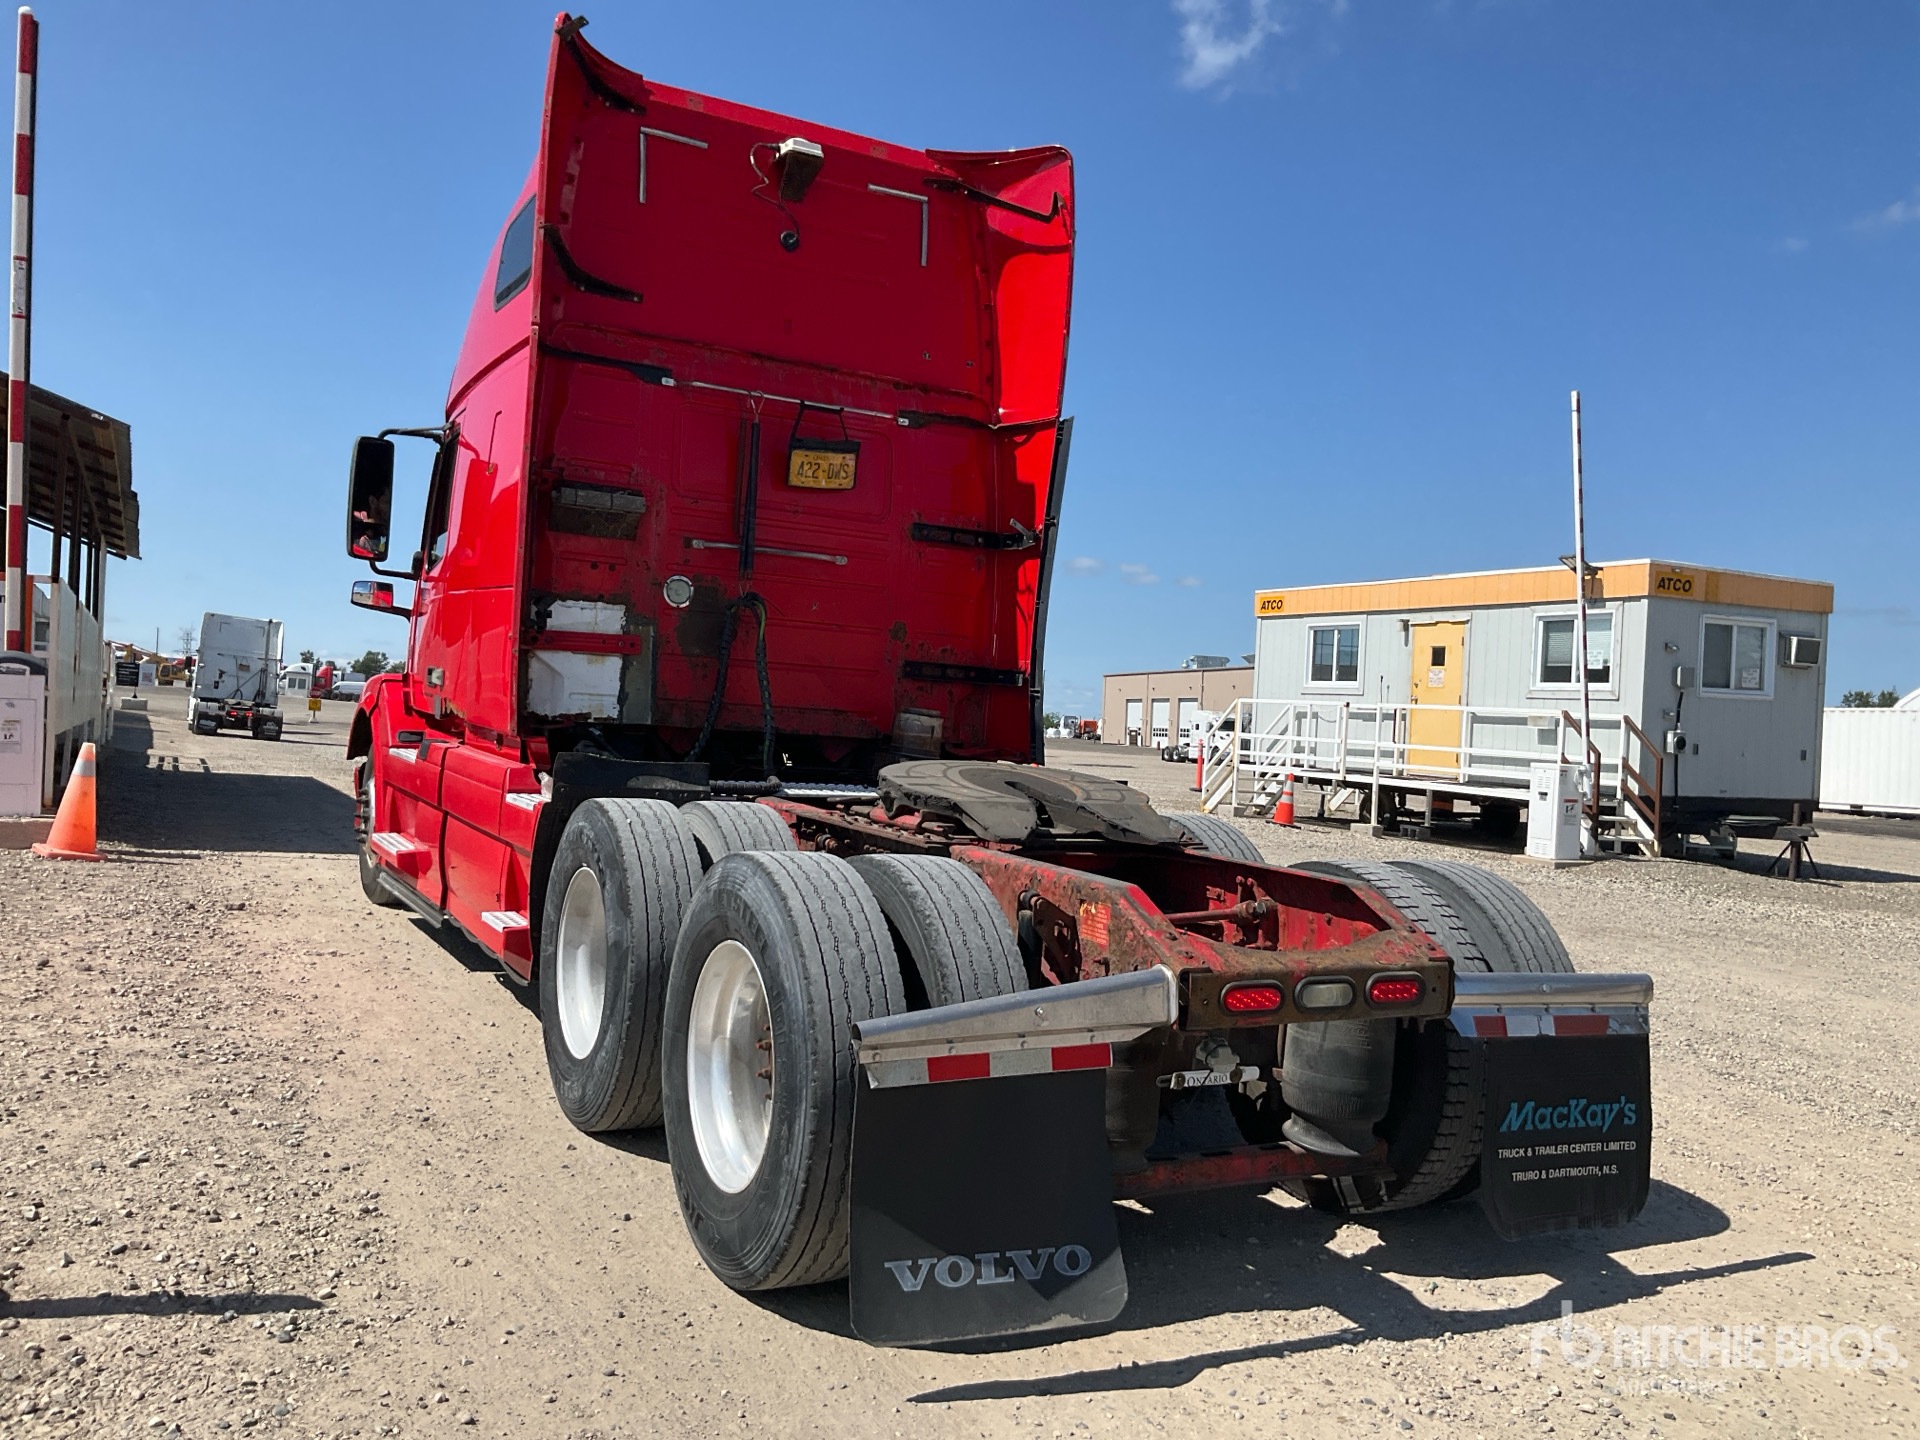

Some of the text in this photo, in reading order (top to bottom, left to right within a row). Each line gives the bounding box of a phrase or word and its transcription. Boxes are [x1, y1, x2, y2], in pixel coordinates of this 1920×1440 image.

[1656, 577, 1692, 592] ATCO
[1260, 599, 1283, 610] ATCO
[1499, 1096, 1637, 1133] MacKay's
[1498, 1141, 1636, 1158] TRUCK & TRAILER CENTER LIMITED
[1512, 1165, 1619, 1181] TRURO & DARTMOUTH, N.S.
[884, 1244, 1092, 1292] VOLVO
